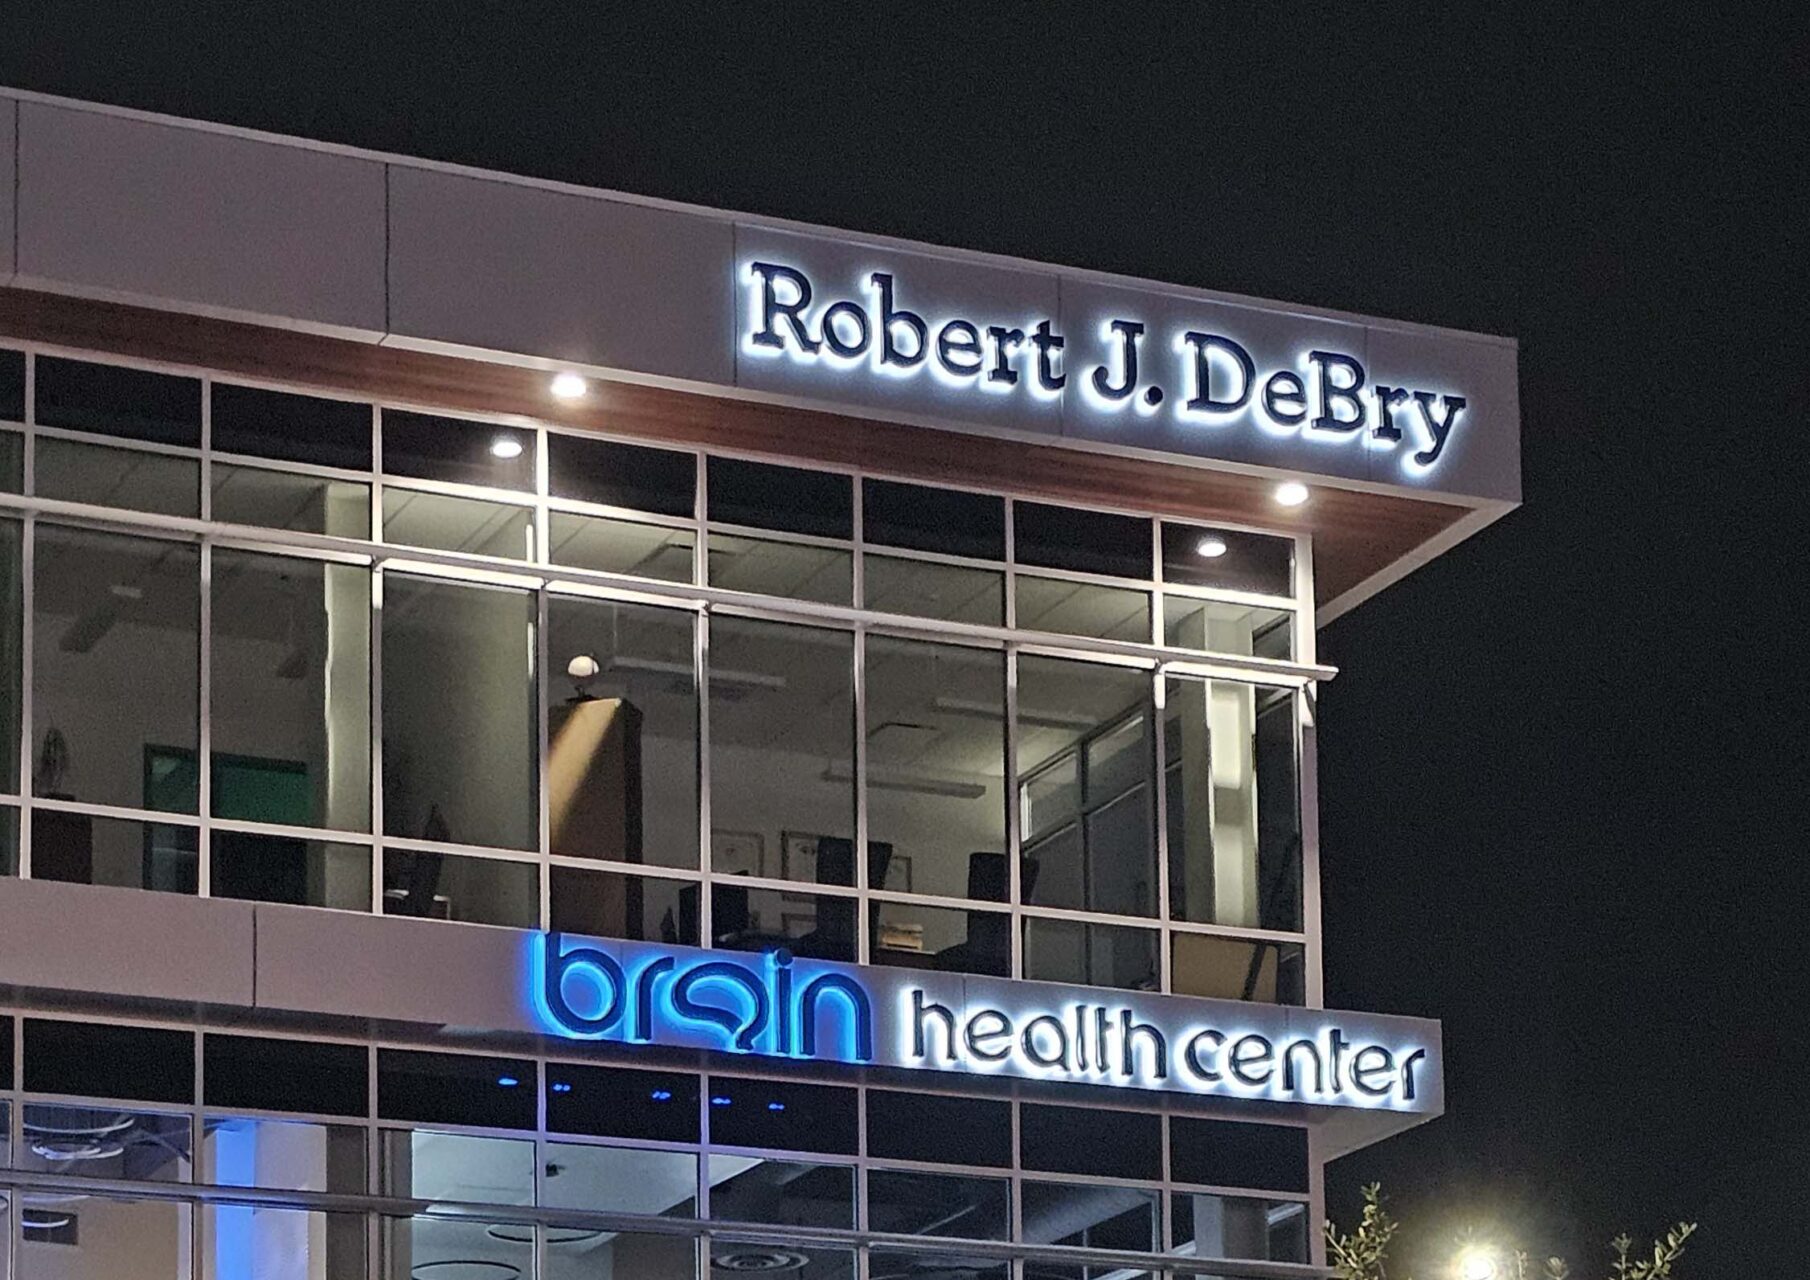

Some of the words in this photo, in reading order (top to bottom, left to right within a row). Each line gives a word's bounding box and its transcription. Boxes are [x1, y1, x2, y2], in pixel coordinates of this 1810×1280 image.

[751, 261, 1066, 392] Robert
[1092, 319, 1164, 407] J.
[1184, 330, 1467, 467] DeBry
[540, 930, 873, 1062] brain
[911, 989, 1168, 1080] health
[1184, 1026, 1426, 1101] center
